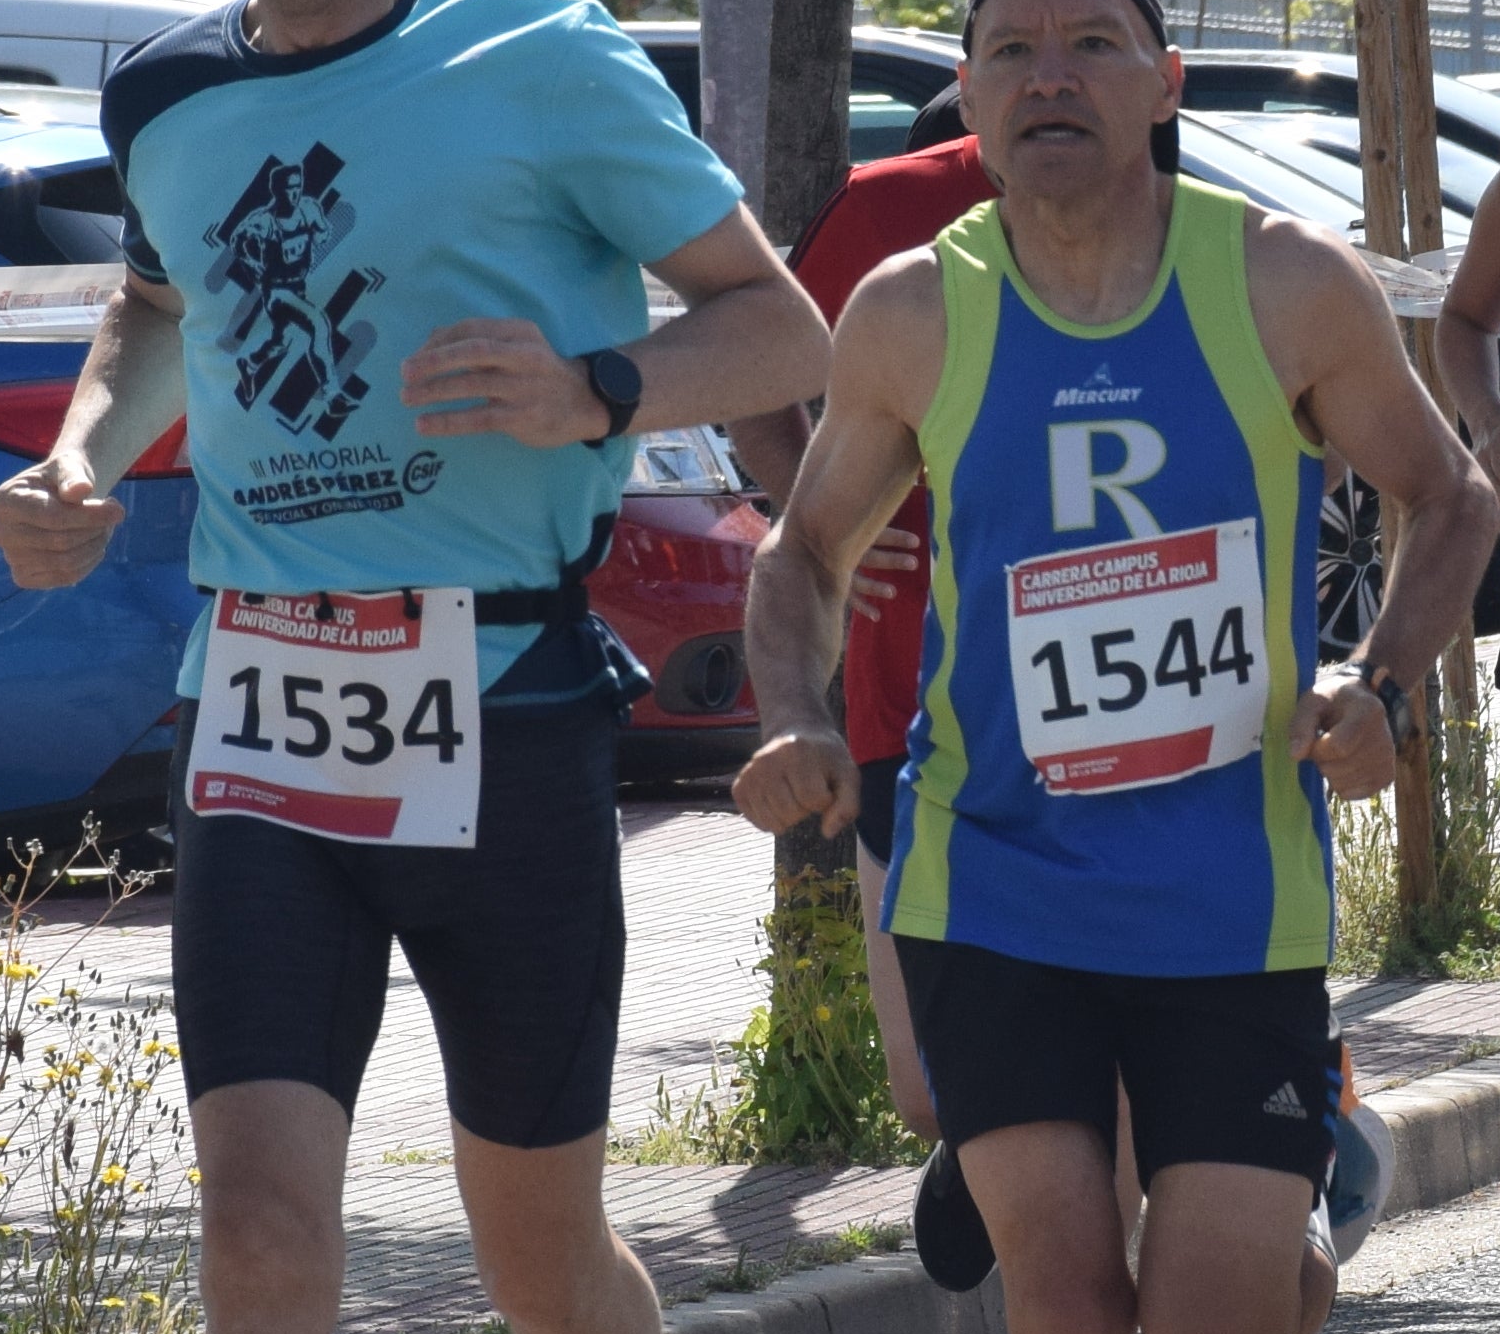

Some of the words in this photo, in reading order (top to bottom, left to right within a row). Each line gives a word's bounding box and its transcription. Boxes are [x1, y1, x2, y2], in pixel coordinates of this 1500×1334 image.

[1054, 388, 1143, 407] MERCURY
[269, 444, 392, 476] MEMORIAL
[411, 460, 445, 482] CSIF
[1048, 419, 1167, 540] R
[234, 472, 322, 506] ANDRÉS
[322, 469, 398, 494] PÉREZ
[1021, 565, 1090, 591] CARRERA
[1093, 552, 1158, 576] CAMPUS
[1021, 578, 1120, 609] UNIVERSIDAD
[1122, 572, 1143, 592] DE
[1147, 569, 1168, 588] LA
[1170, 561, 1208, 583] RIOJA
[232, 609, 318, 641] UNIVERSIDAD
[319, 625, 340, 644] DE
[340, 627, 358, 647] LA
[361, 625, 407, 648] RIOJA
[1031, 606, 1254, 723] 1544
[221, 666, 463, 765] 1534
[1262, 1101, 1308, 1120] adidas
